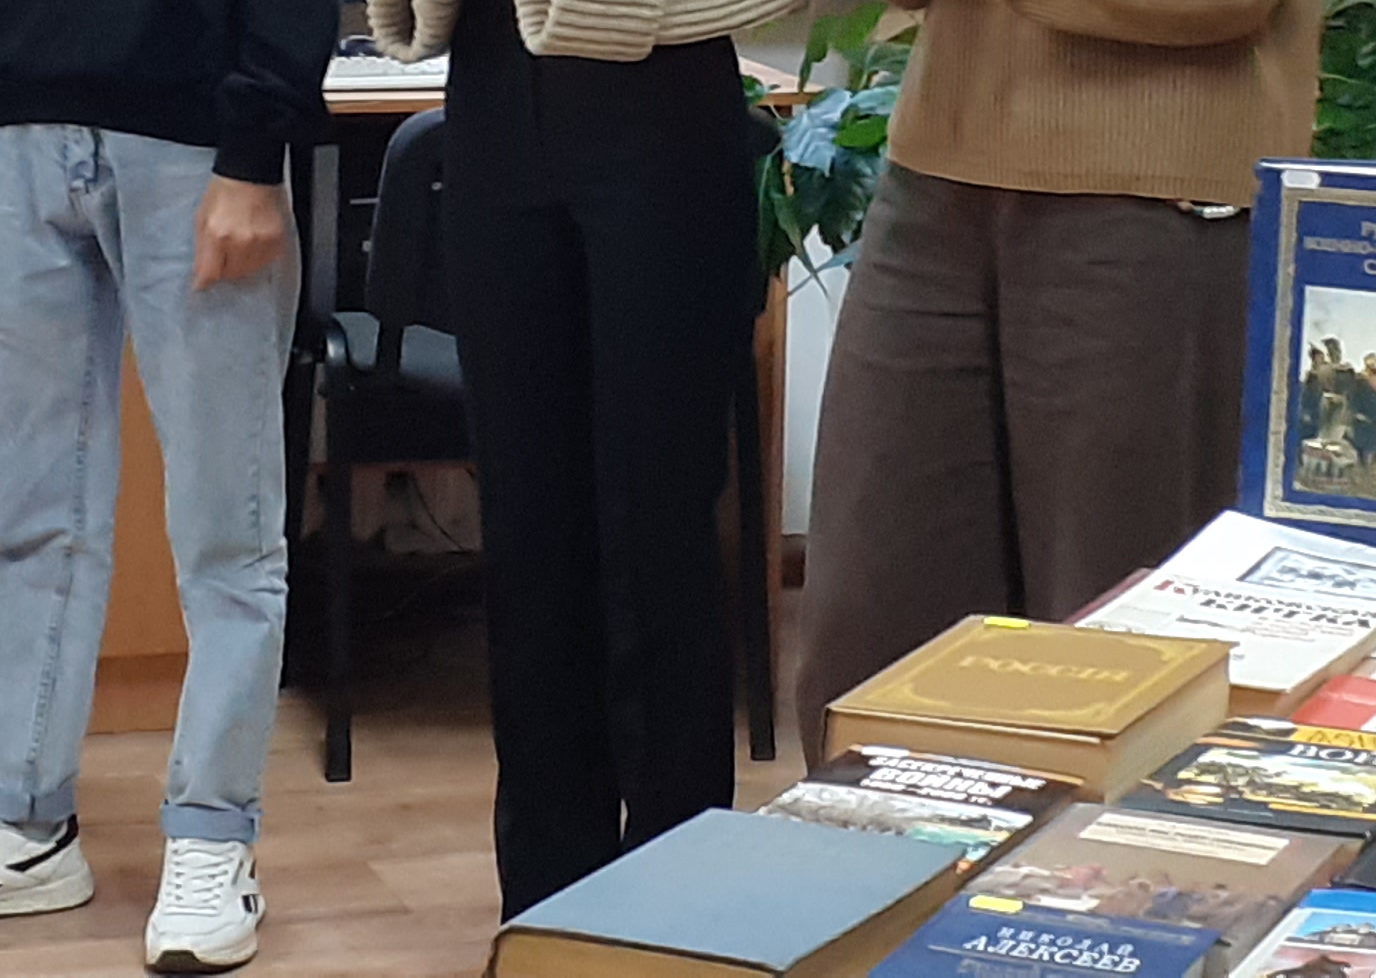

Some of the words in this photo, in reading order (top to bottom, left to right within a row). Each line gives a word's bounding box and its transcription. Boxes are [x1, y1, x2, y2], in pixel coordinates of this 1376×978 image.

[958, 654, 1134, 683] РОССИЯ
[869, 767, 1013, 799] ВОЙНЫ
[961, 934, 1142, 973] АЛЕКСЕЕВ
[996, 926, 1135, 956] НИКОЛАЙ
